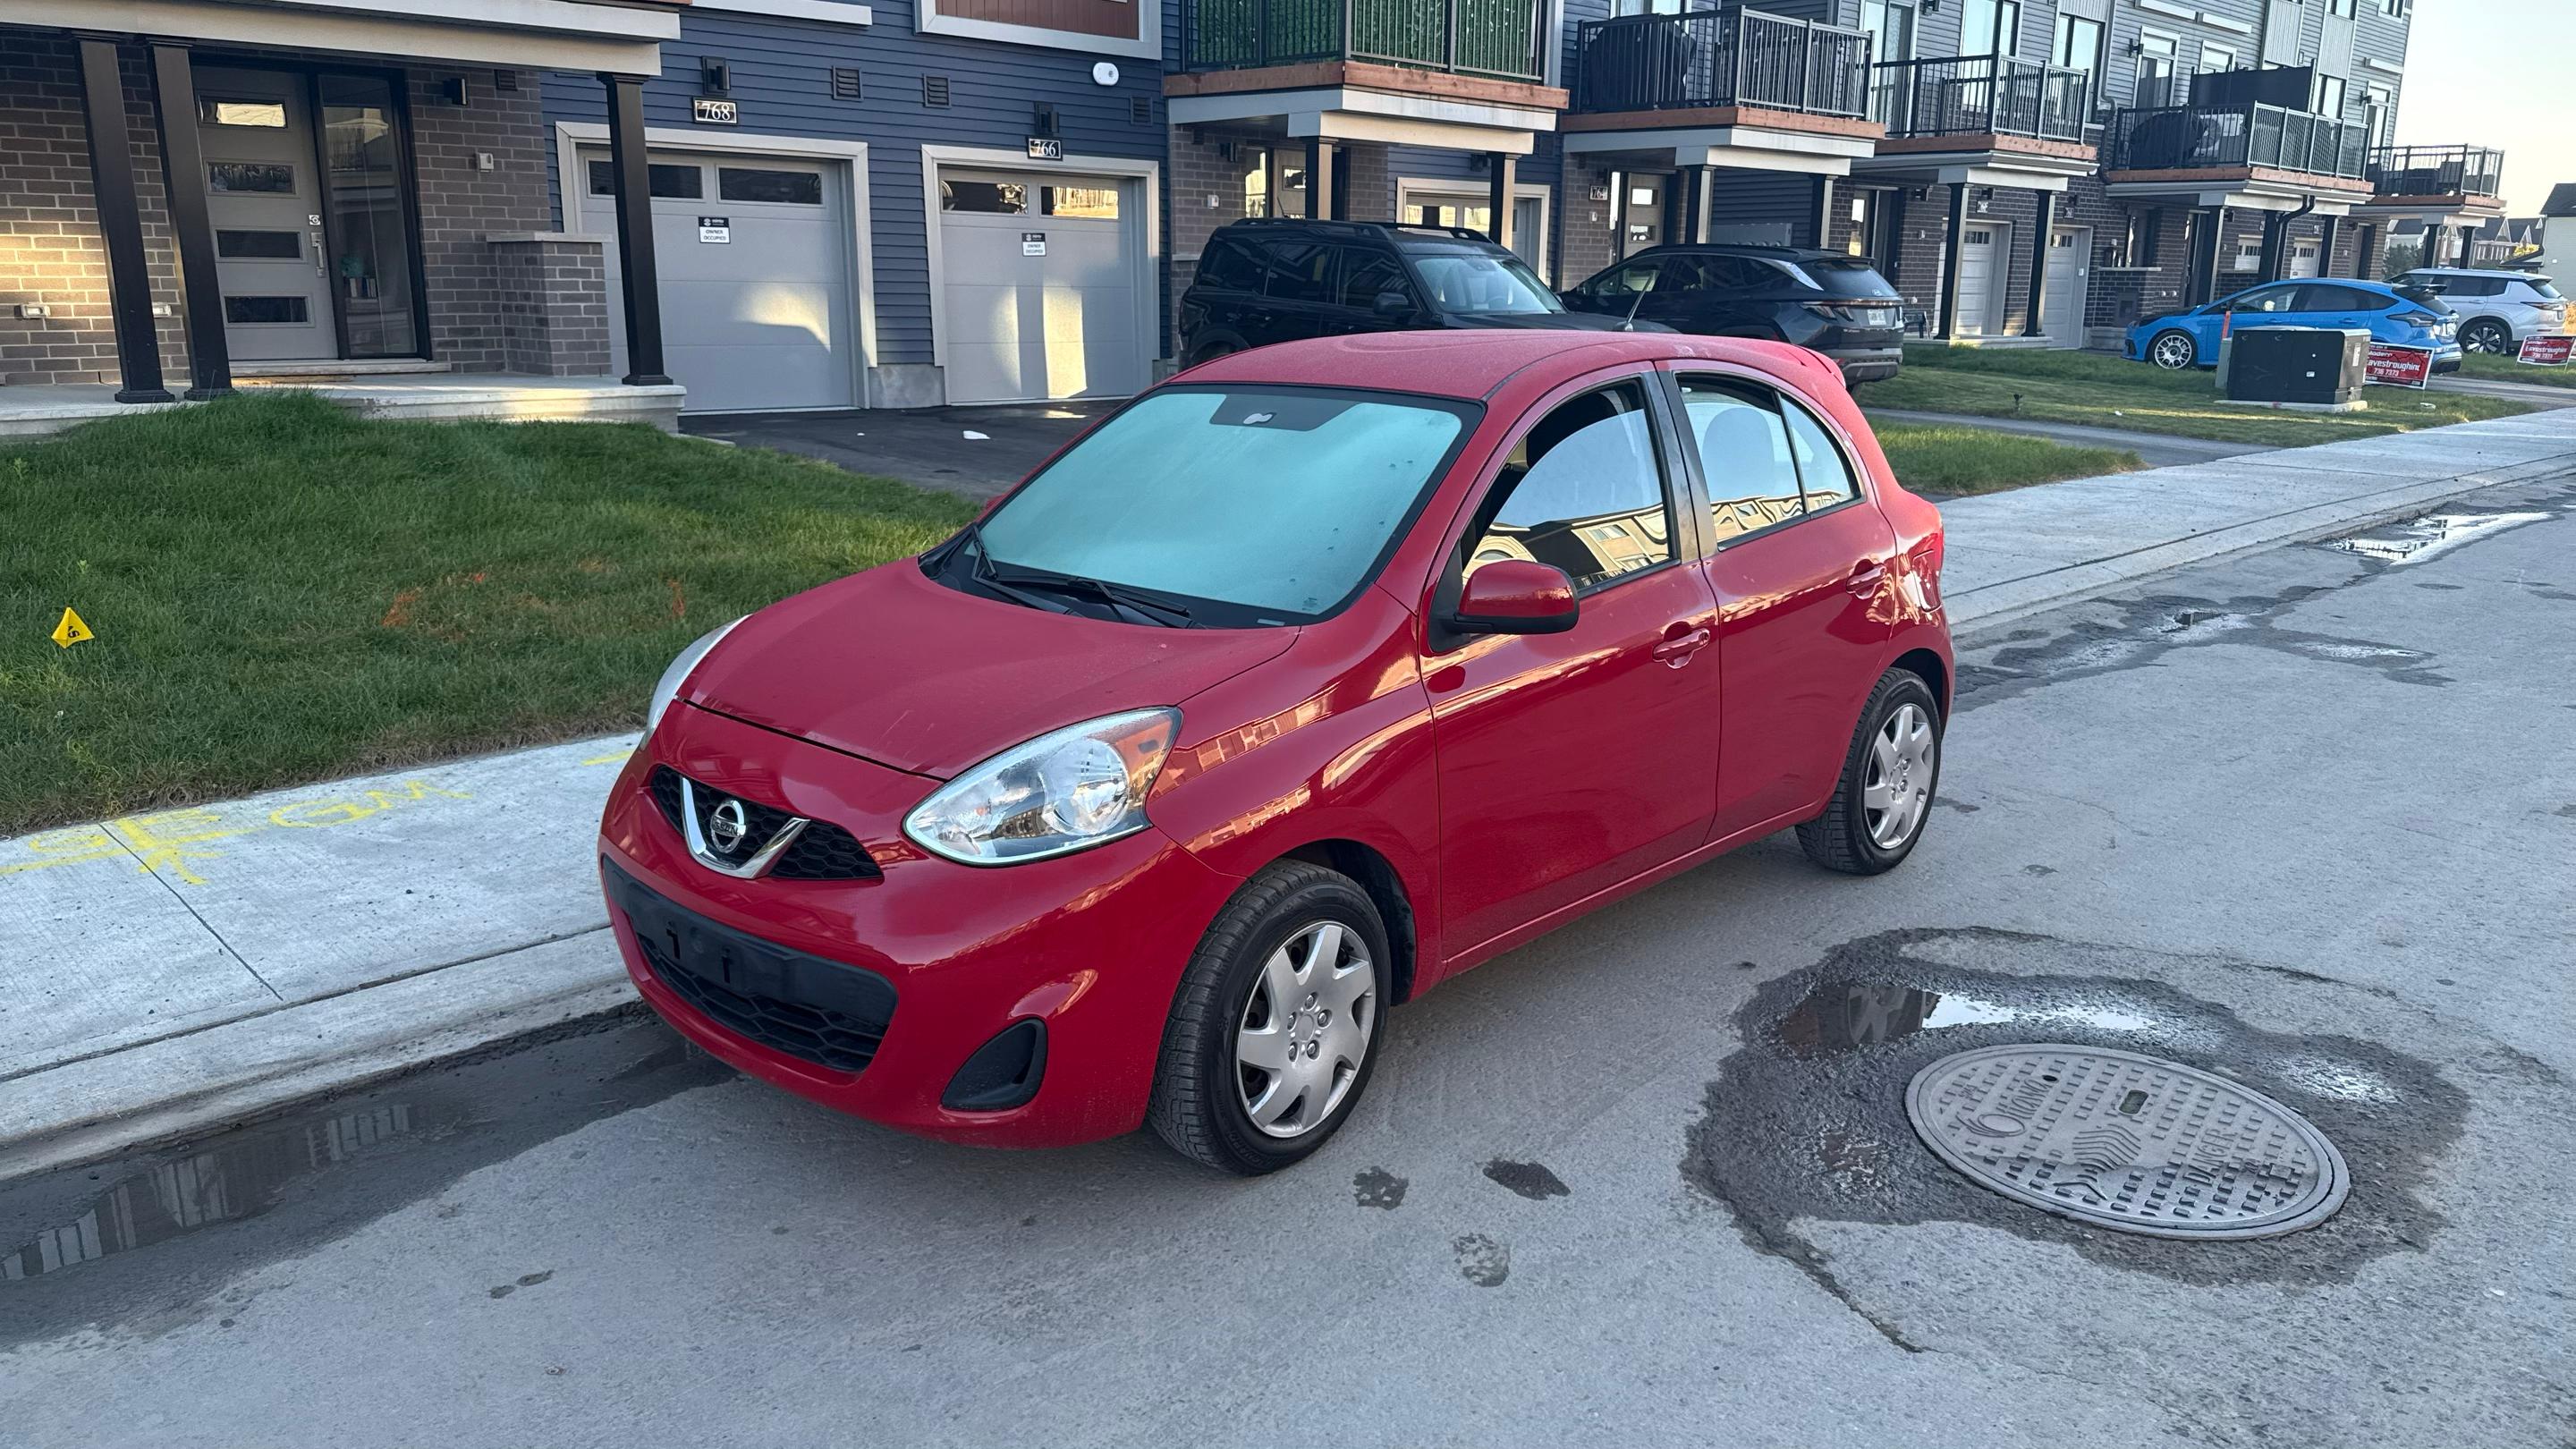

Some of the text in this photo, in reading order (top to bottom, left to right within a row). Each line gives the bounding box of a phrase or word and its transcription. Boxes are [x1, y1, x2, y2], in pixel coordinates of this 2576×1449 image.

[701, 103, 731, 121] 768
[1033, 141, 1056, 157] 766
[2385, 368, 2400, 377] 7373
[1954, 1078, 2055, 1139] Ottawa
[2182, 1128, 2238, 1186] DANGER
